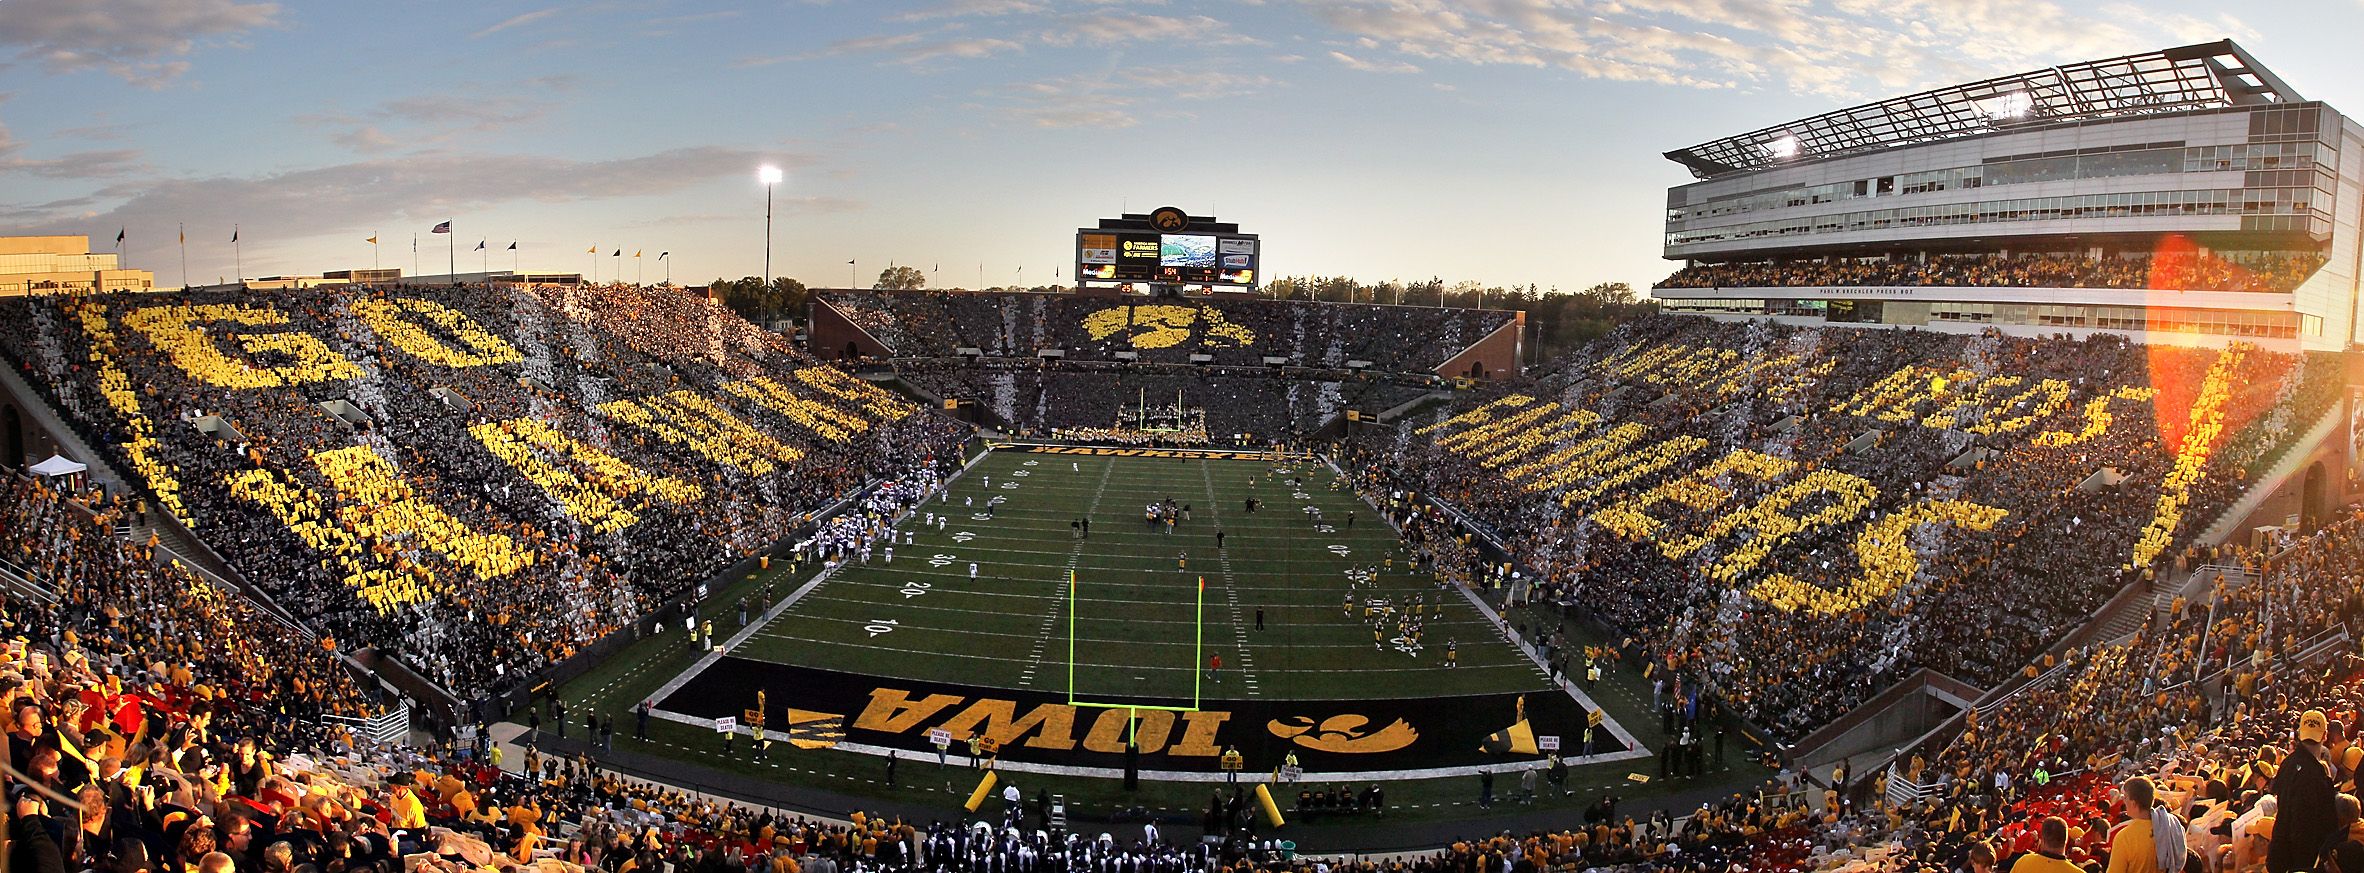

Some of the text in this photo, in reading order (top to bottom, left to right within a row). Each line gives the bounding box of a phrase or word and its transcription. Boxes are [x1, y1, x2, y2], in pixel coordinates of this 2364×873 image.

[1121, 285, 1131, 293] 25
[1202, 287, 1212, 295] 25
[121, 297, 523, 390] GO
[1413, 392, 2010, 619] FARMERS
[899, 581, 932, 596] 20
[864, 619, 899, 634] 10
[852, 687, 1231, 757] IOWA
[931, 730, 945, 738] PLEASE
[983, 737, 995, 745] GO
